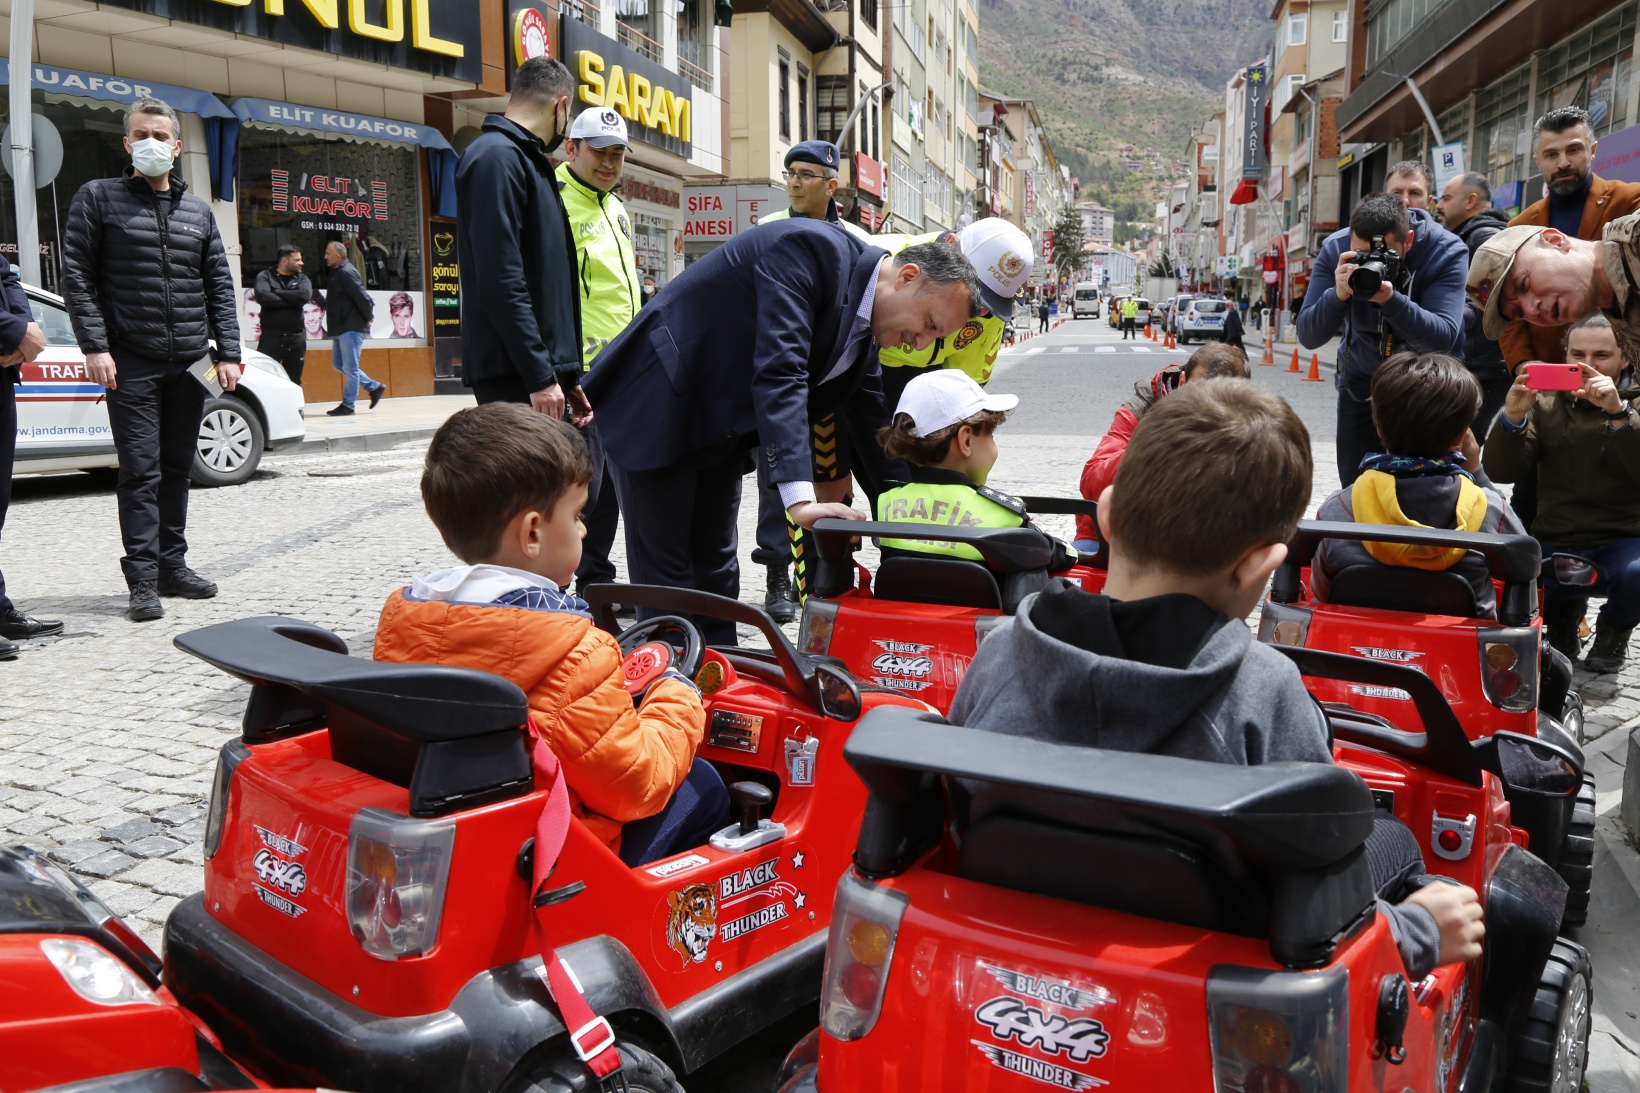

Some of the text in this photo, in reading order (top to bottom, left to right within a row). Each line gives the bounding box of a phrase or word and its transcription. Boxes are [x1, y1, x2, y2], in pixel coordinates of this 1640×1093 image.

[8, 63, 153, 99] UAFÖR
[578, 50, 691, 142] SARAYI
[268, 105, 418, 139] ELİT KUAFÖR
[292, 195, 372, 218] KUAFÖR
[688, 192, 723, 216] ŞİFA
[301, 220, 314, 230] GSM
[318, 222, 323, 230] 0
[346, 224, 353, 232] 72
[684, 216, 733, 236] ANESİ
[432, 263, 459, 280] gönül
[38, 362, 89, 379] TRAFİ
[881, 497, 985, 529] TRAFİK
[889, 642, 916, 653] BLACK
[1371, 648, 1404, 660] BLACK
[885, 679, 918, 690] THUNDER
[1365, 686, 1407, 699] THUNDER
[267, 833, 292, 854] BLACK
[719, 857, 781, 900] BLACK
[263, 890, 293, 915] THUNDER
[719, 902, 789, 943] THUNDER
[1014, 974, 1074, 1007] BLACK
[1001, 1051, 1075, 1089] THUNDER
